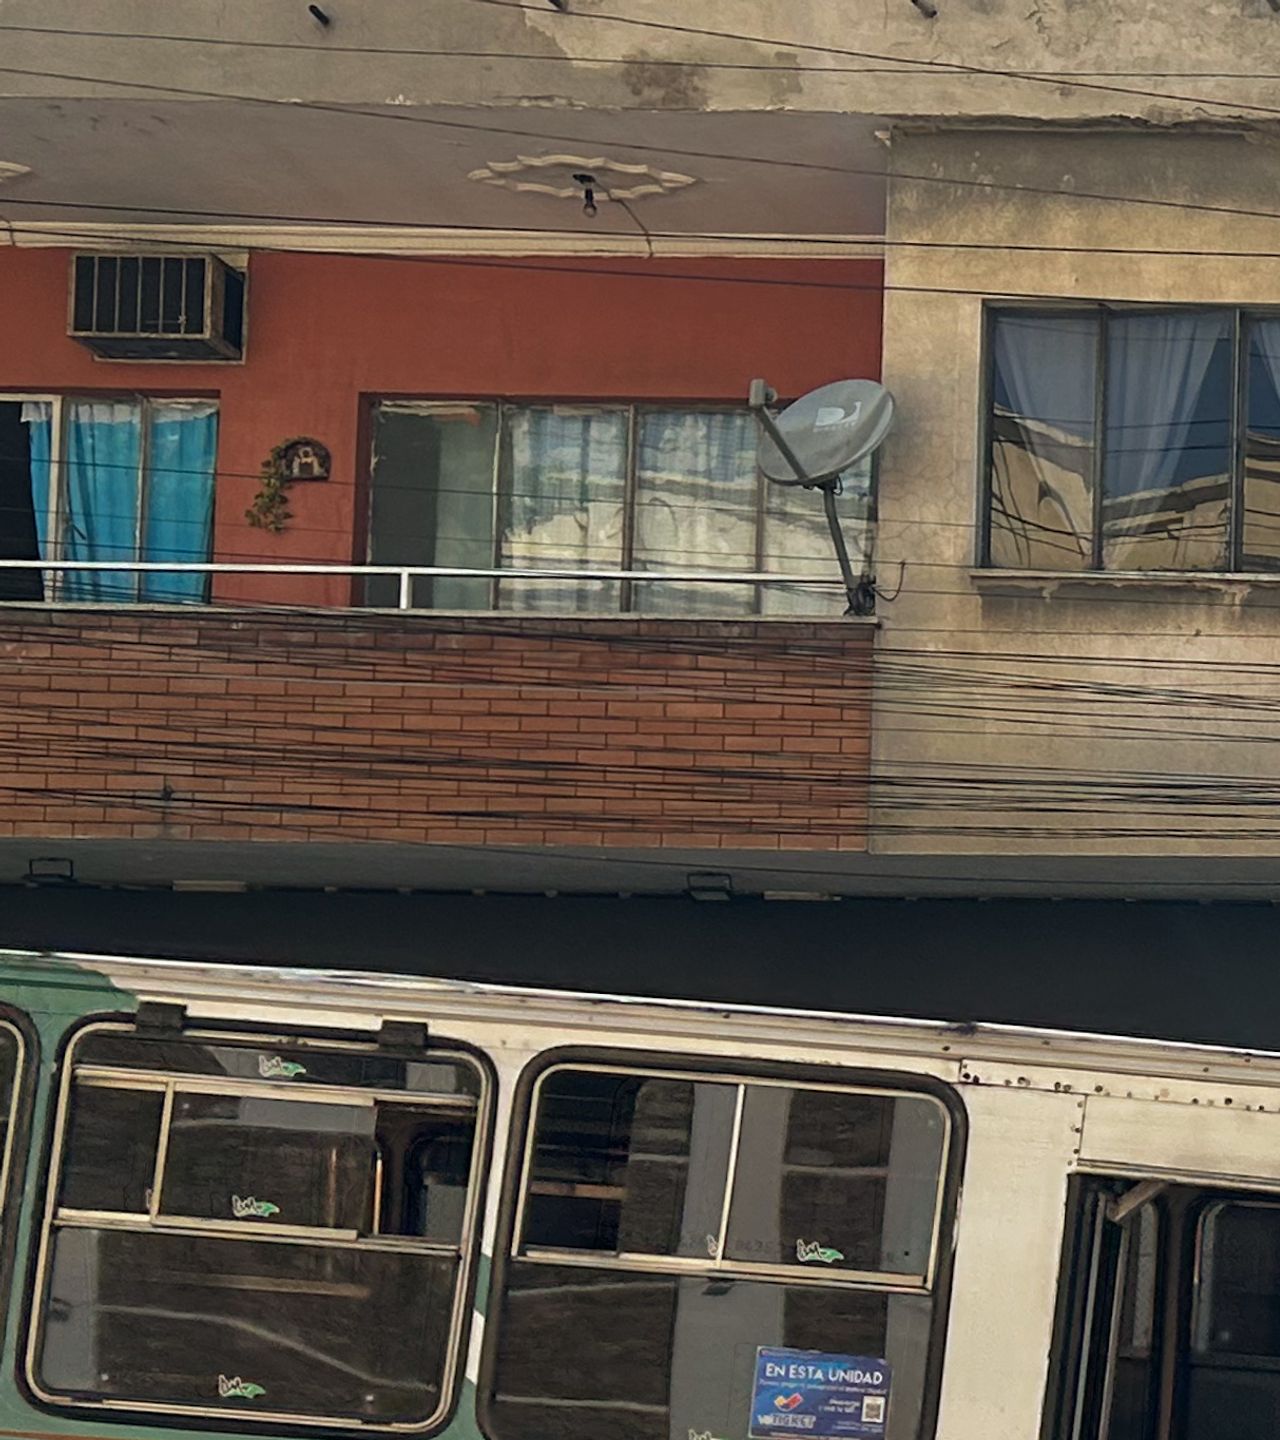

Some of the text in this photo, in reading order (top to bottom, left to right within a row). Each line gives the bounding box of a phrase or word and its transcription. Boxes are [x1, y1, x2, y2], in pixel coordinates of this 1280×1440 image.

[765, 1363, 883, 1385] EN ESTA UNIDAD
